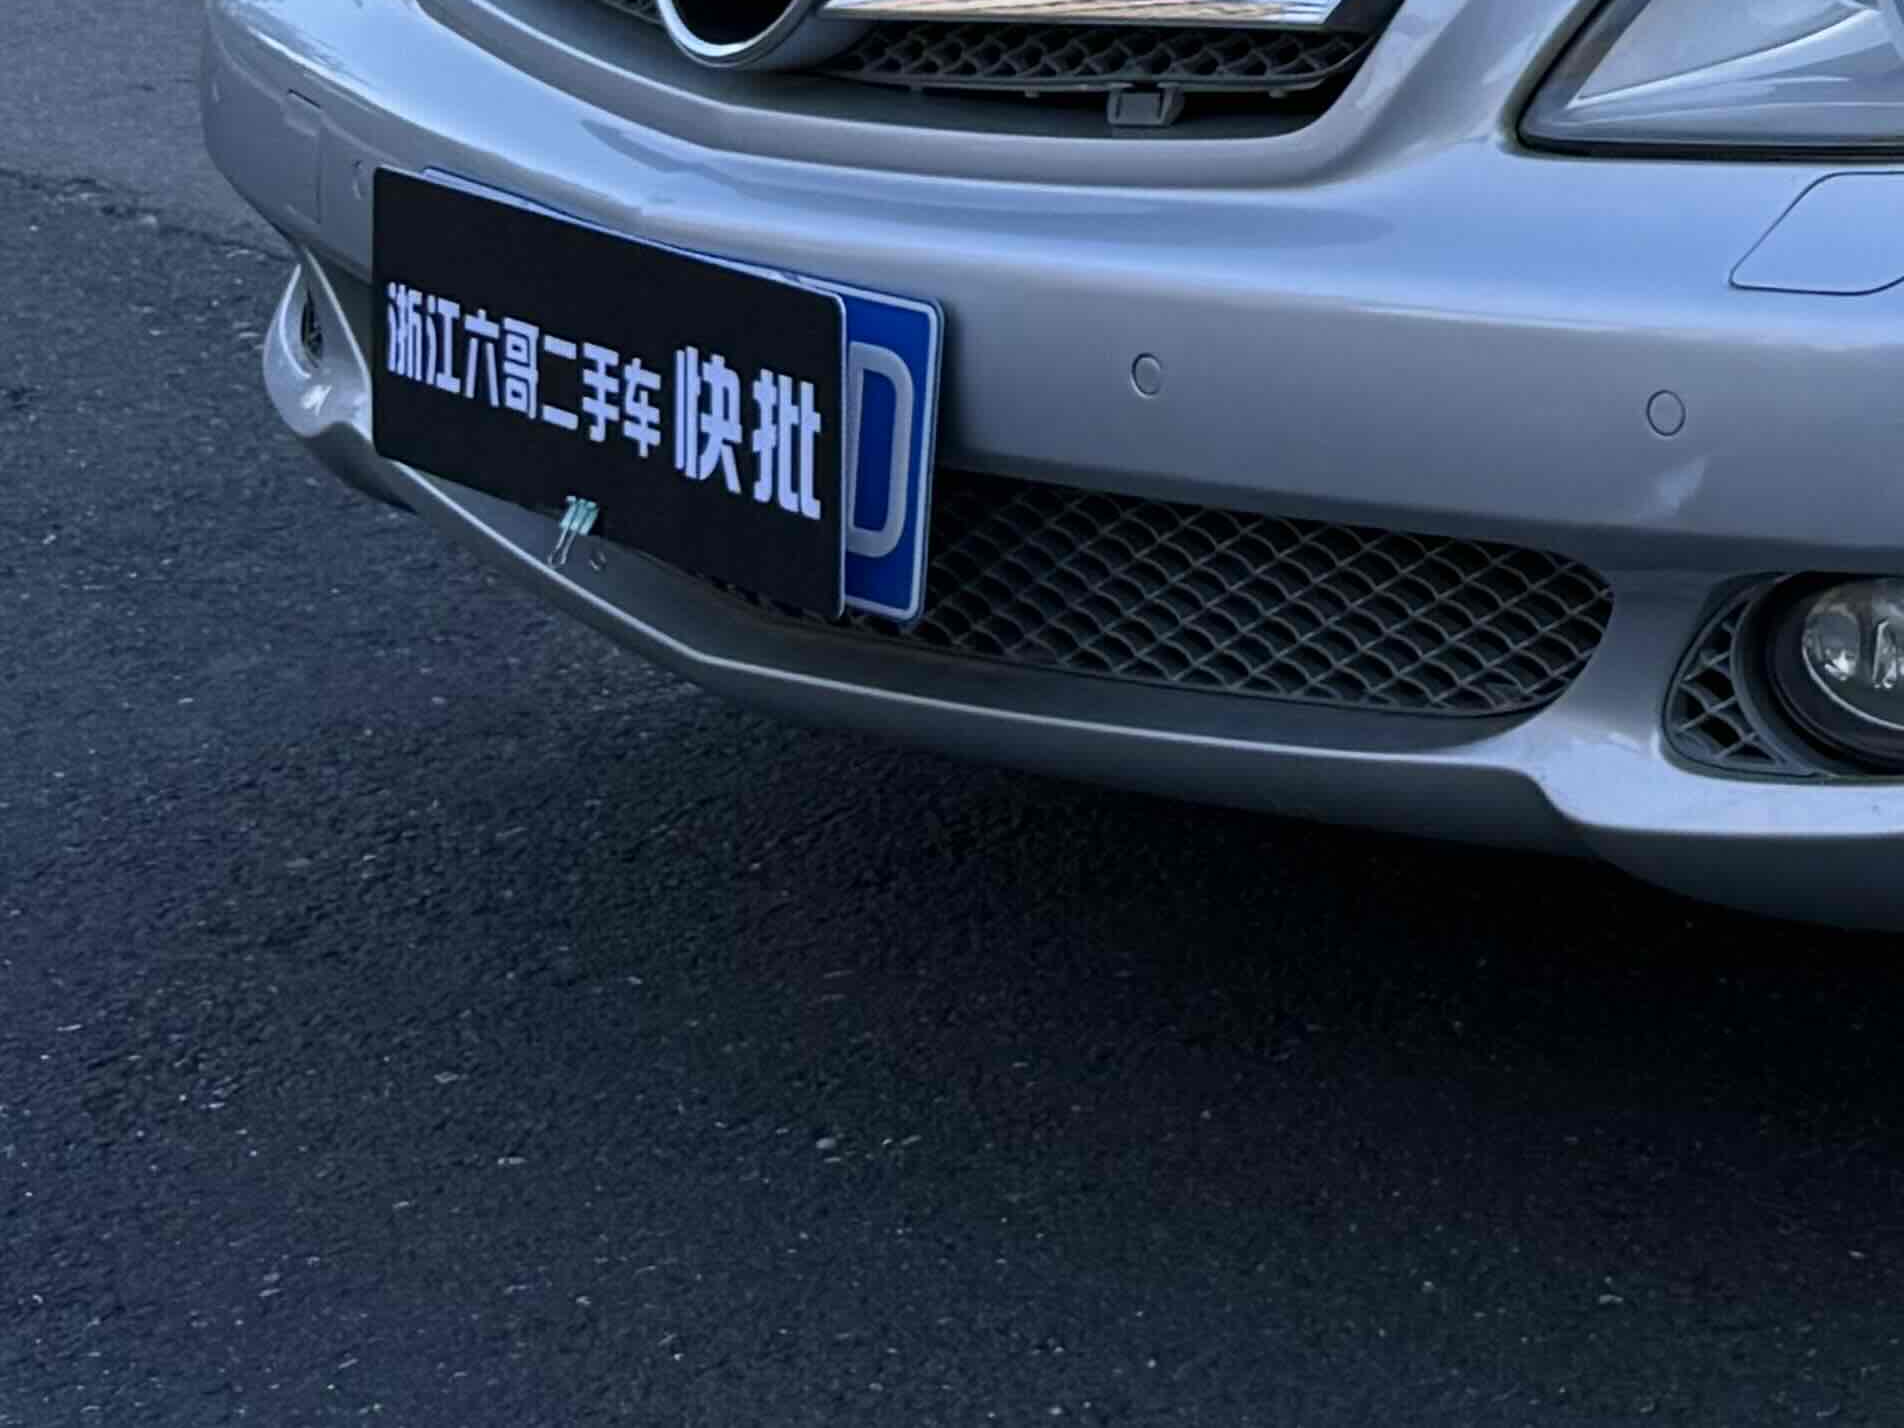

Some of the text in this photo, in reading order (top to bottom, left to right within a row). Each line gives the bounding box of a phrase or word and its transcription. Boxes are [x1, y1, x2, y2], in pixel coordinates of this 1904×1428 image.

[386, 282, 822, 521] 浙江六哥二手车 快批
[847, 341, 915, 559] D
